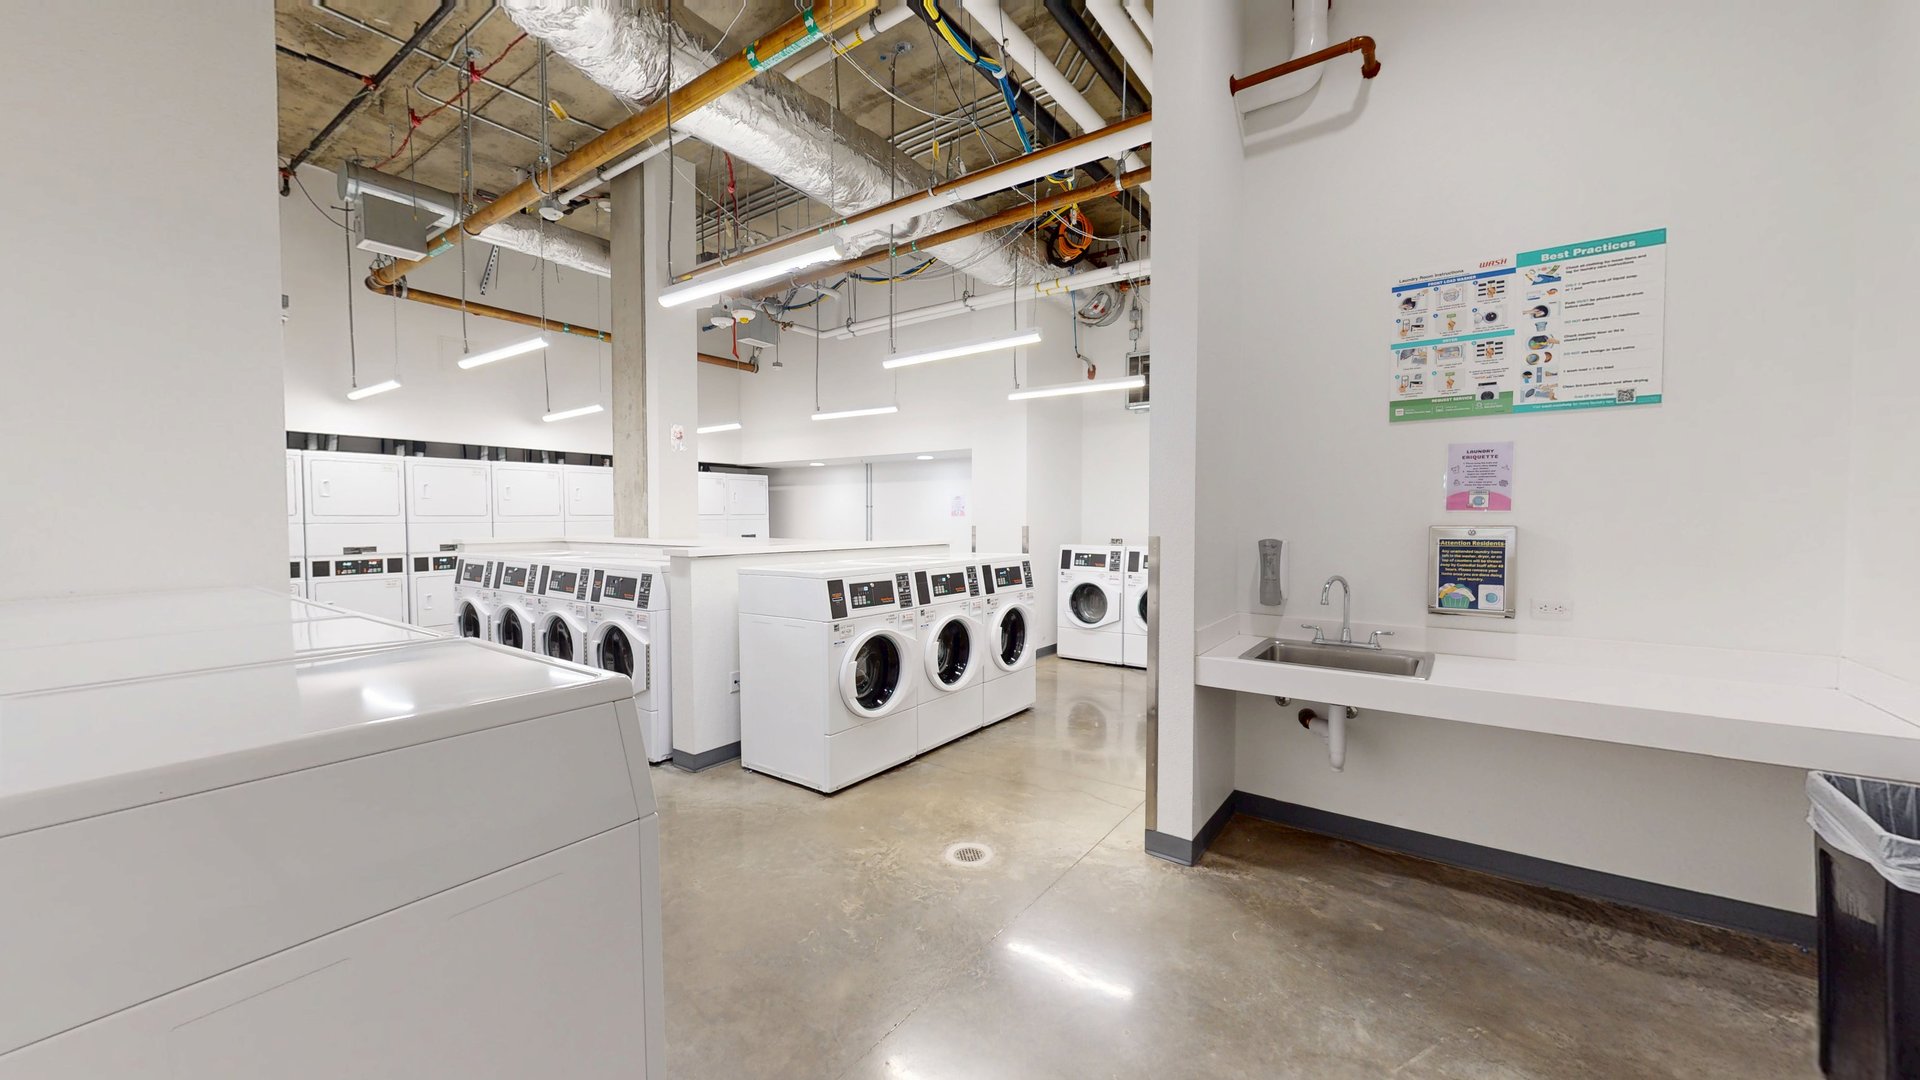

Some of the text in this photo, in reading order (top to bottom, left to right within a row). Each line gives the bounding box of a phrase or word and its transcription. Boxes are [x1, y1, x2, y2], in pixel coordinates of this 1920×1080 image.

[1541, 240, 1636, 262] Best Practices
[1479, 258, 1507, 268] WASH
